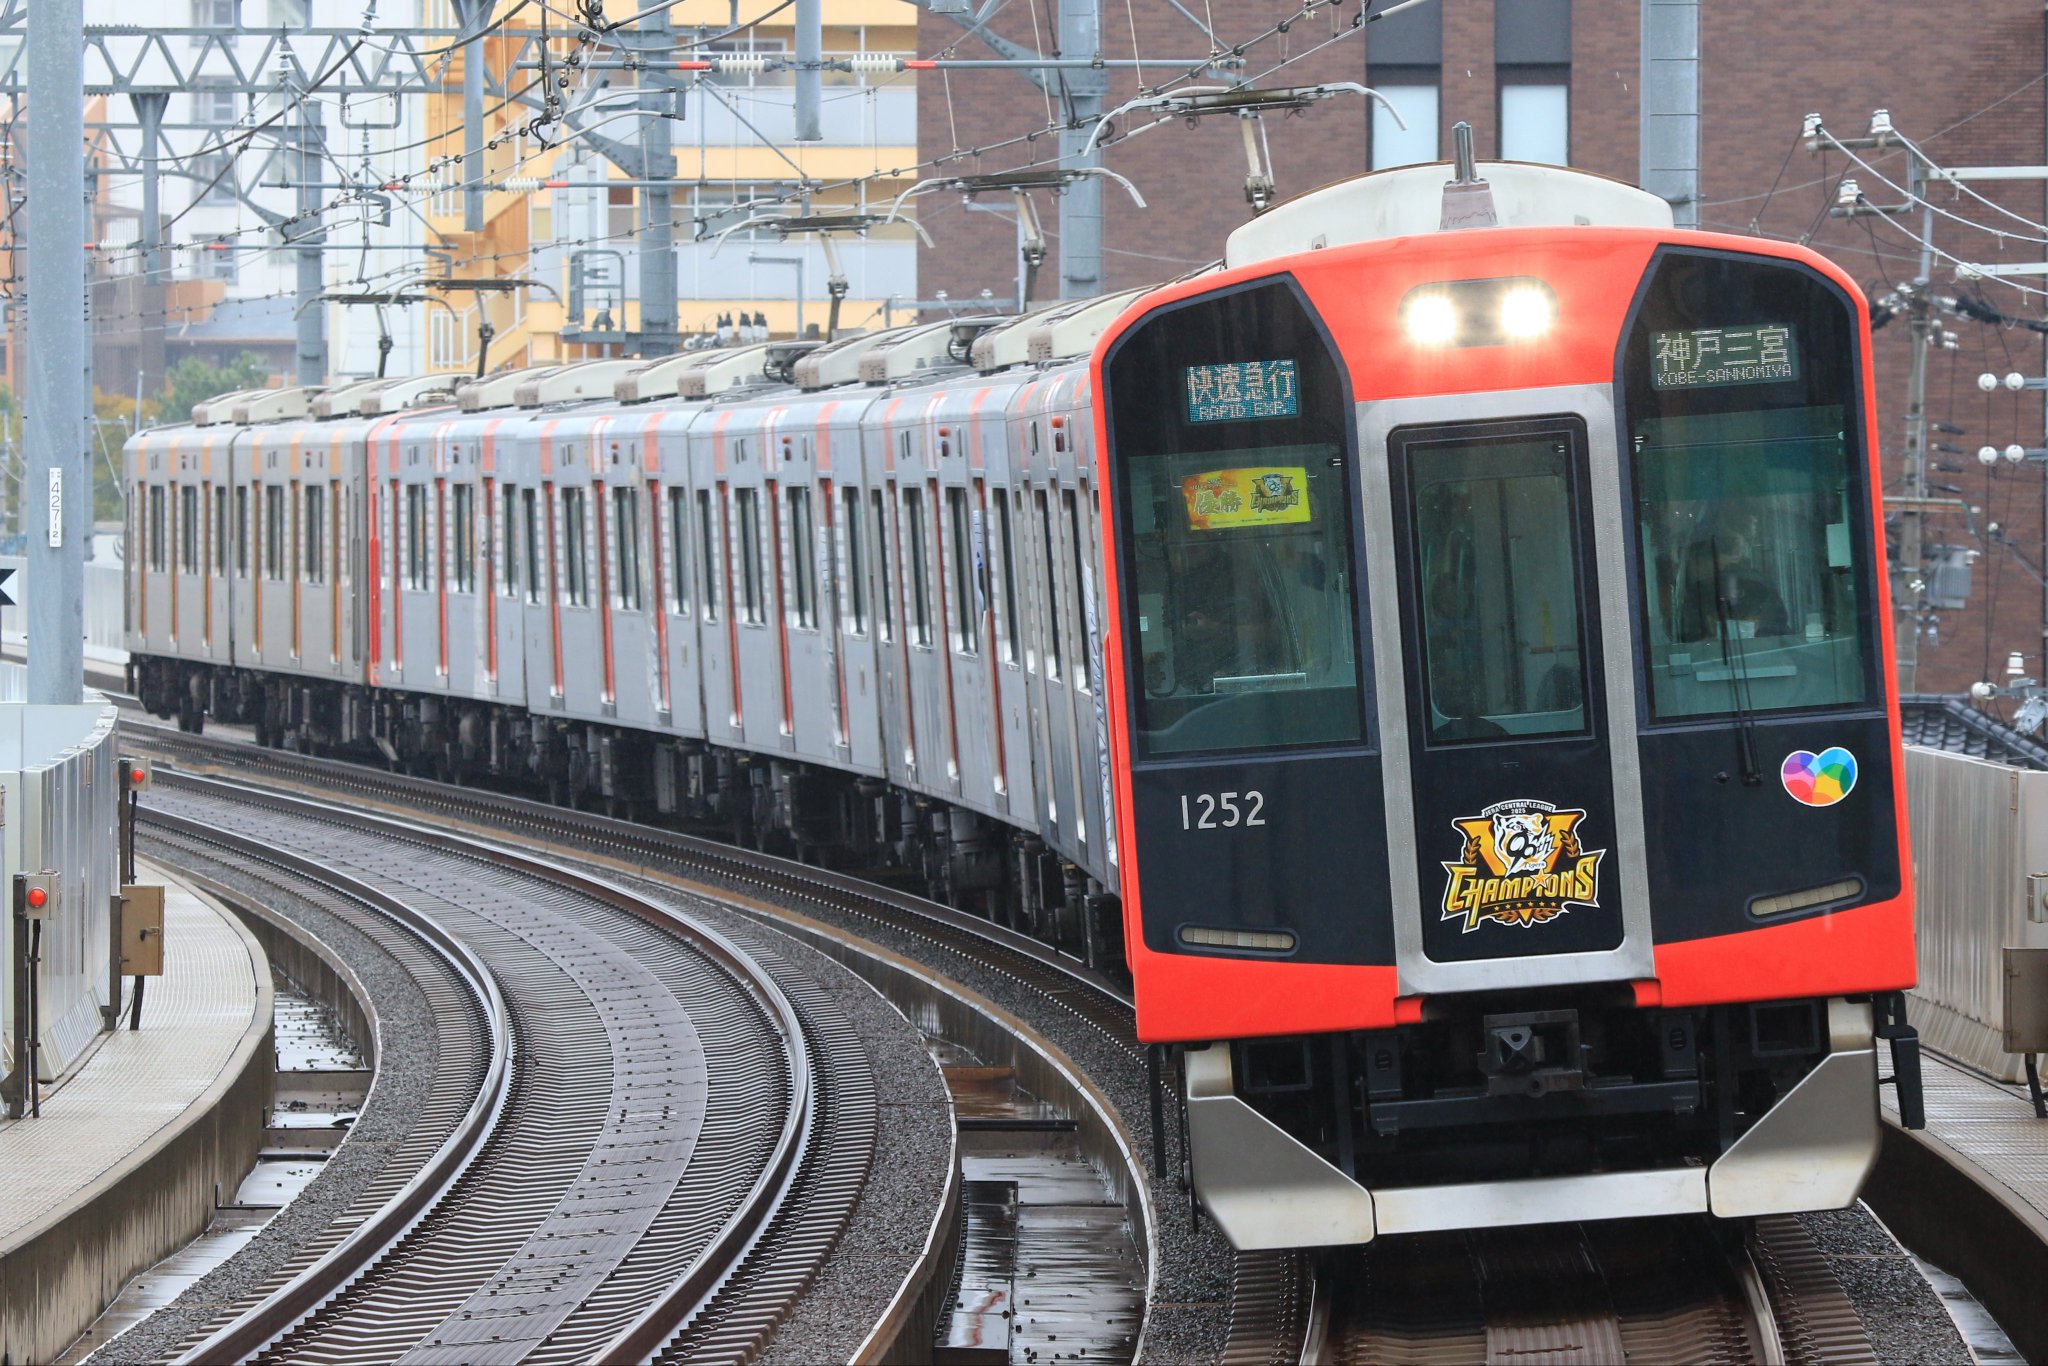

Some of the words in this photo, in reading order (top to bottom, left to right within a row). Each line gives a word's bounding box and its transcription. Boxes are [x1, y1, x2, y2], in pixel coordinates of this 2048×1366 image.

[1656, 325, 1789, 371] 神戸三宮
[1656, 364, 1792, 386] KOBE-SANNOMIYA
[1181, 790, 1266, 831] 1252
[1500, 801, 1528, 811] CENTRAL
[1529, 802, 1553, 813] LEAGUE
[1446, 856, 1598, 927] CHAMPIONS
